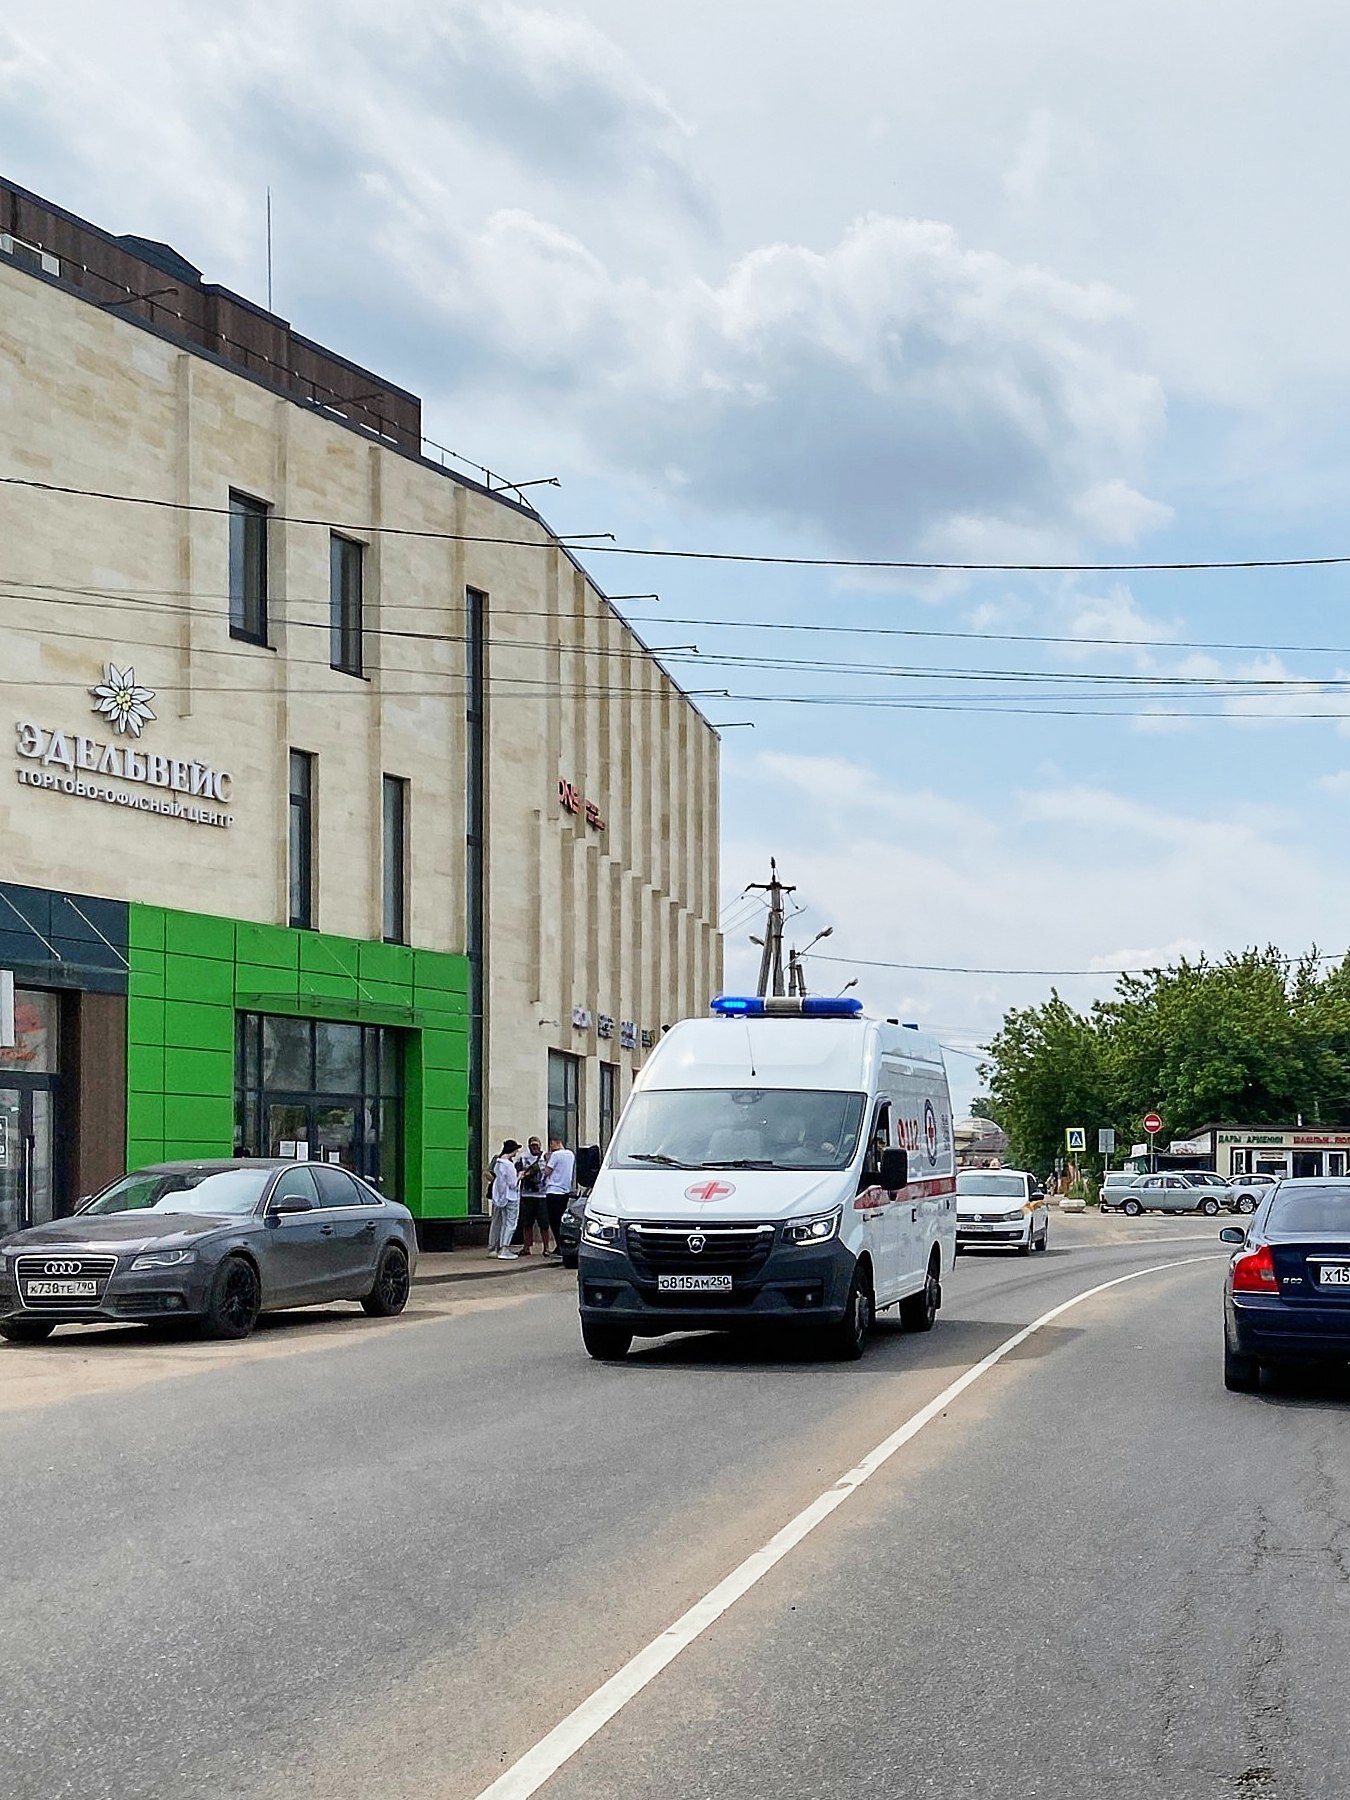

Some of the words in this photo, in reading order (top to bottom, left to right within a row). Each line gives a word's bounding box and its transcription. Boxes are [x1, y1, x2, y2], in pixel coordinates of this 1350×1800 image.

[16, 721, 233, 803] ЭДЕЛЬВЕЙС
[18, 769, 186, 818] ТОРГОВО-ОФИСНЫЙ
[187, 807, 234, 829] ЦЕНТР
